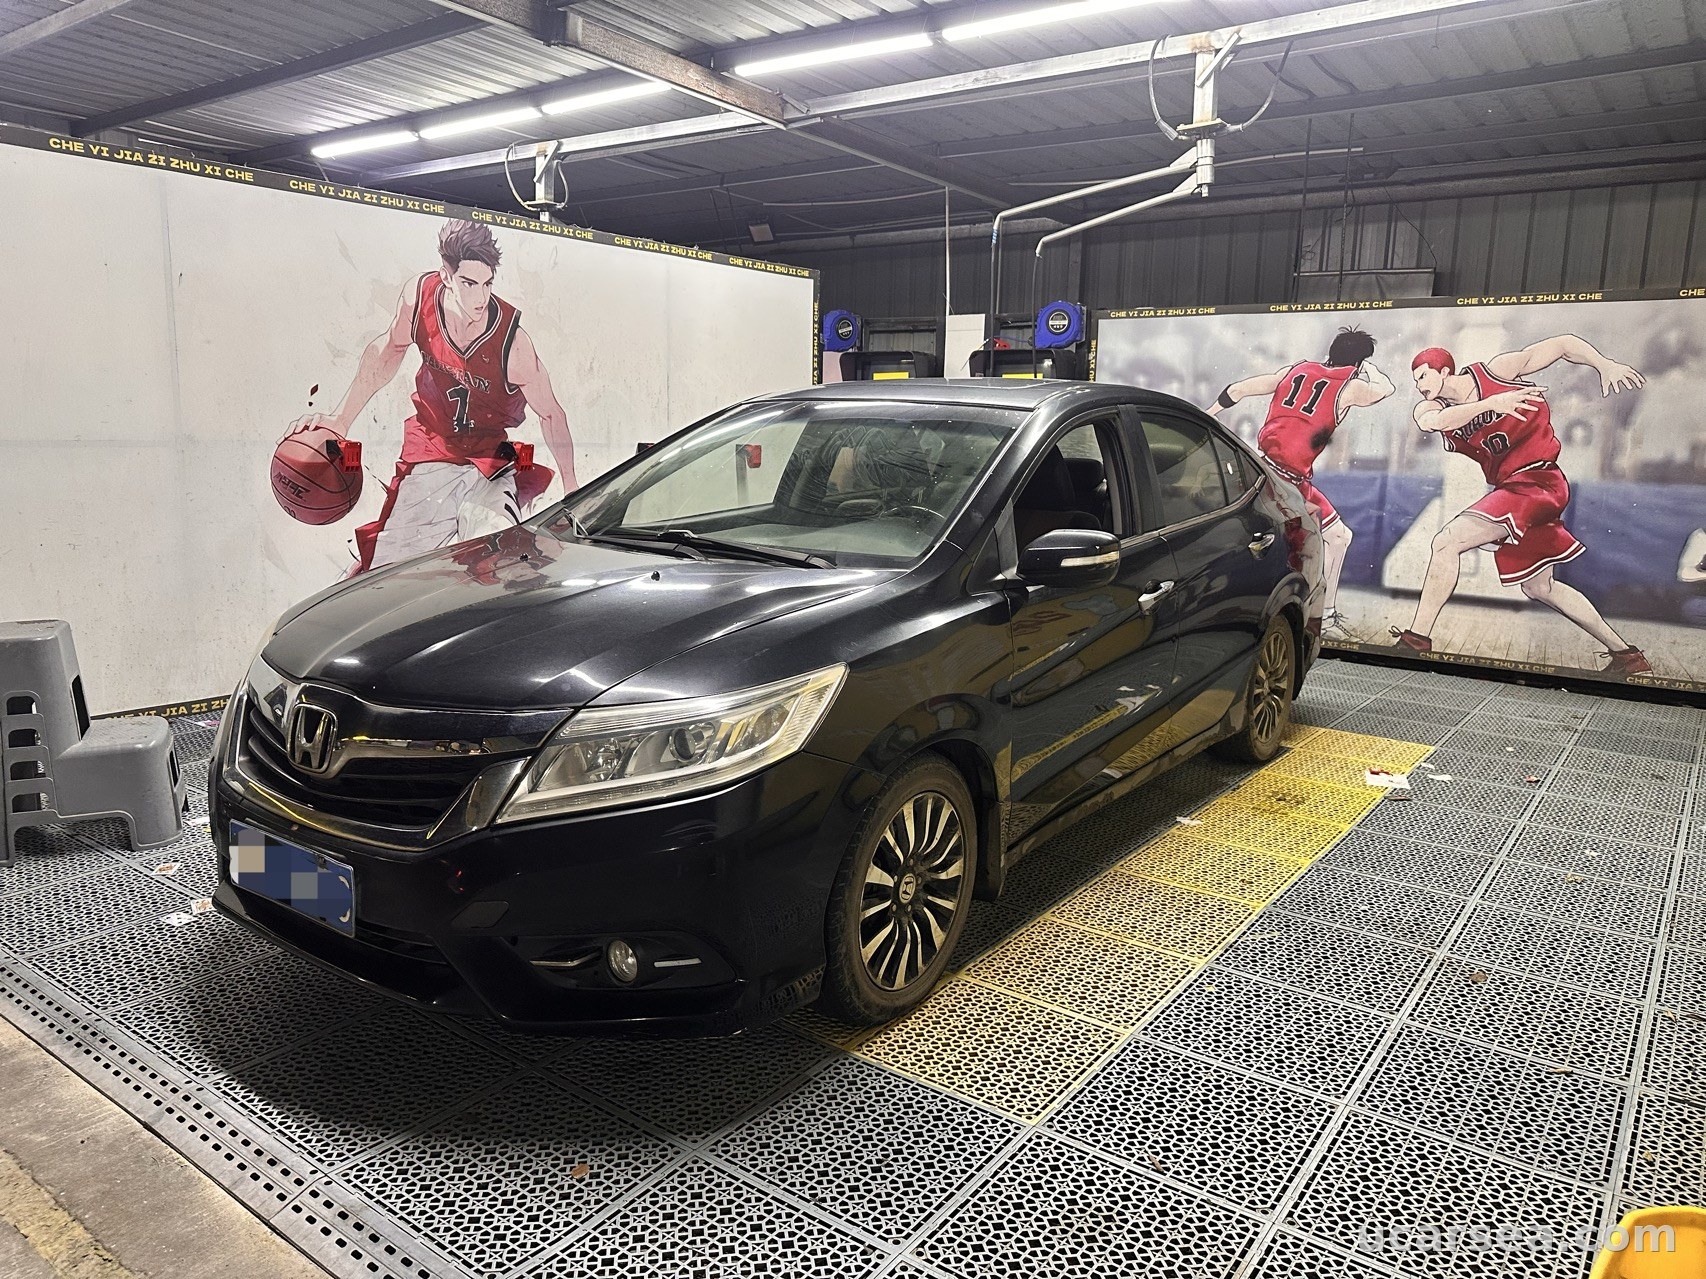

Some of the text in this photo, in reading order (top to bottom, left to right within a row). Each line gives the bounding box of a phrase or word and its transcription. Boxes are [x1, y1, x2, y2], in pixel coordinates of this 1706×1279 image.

[49, 137, 254, 182] CHE YI JIA ZI ZHU XI CHE
[289, 179, 445, 214] CHE YI JIA ZI ZHU XI CHE
[471, 211, 593, 239] CHE YI JIA ZI ZHU XI CHE
[614, 237, 713, 261] CHE YI JIA ZI ZHU XI CHE
[729, 257, 743, 266] CHE
[744, 260, 752, 268] YI
[753, 262, 766, 270] JIA
[766, 264, 775, 272] ZI
[775, 265, 788, 274] ZHU
[796, 269, 809, 277] CHE
[1456, 297, 1479, 305] CHE
[1536, 294, 1560, 302] ZHU
[1679, 288, 1706, 296] CHE
[1304, 303, 1321, 311] JIA
[1336, 302, 1357, 310] ZHU
[1358, 301, 1370, 309] XI
[1282, 373, 1330, 416] 11
[1626, 676, 1651, 685] CHE
[1671, 681, 1693, 689] JIA
[161, 706, 187, 717] JIA
[191, 702, 208, 713] ZI
[211, 698, 229, 708] ZH
